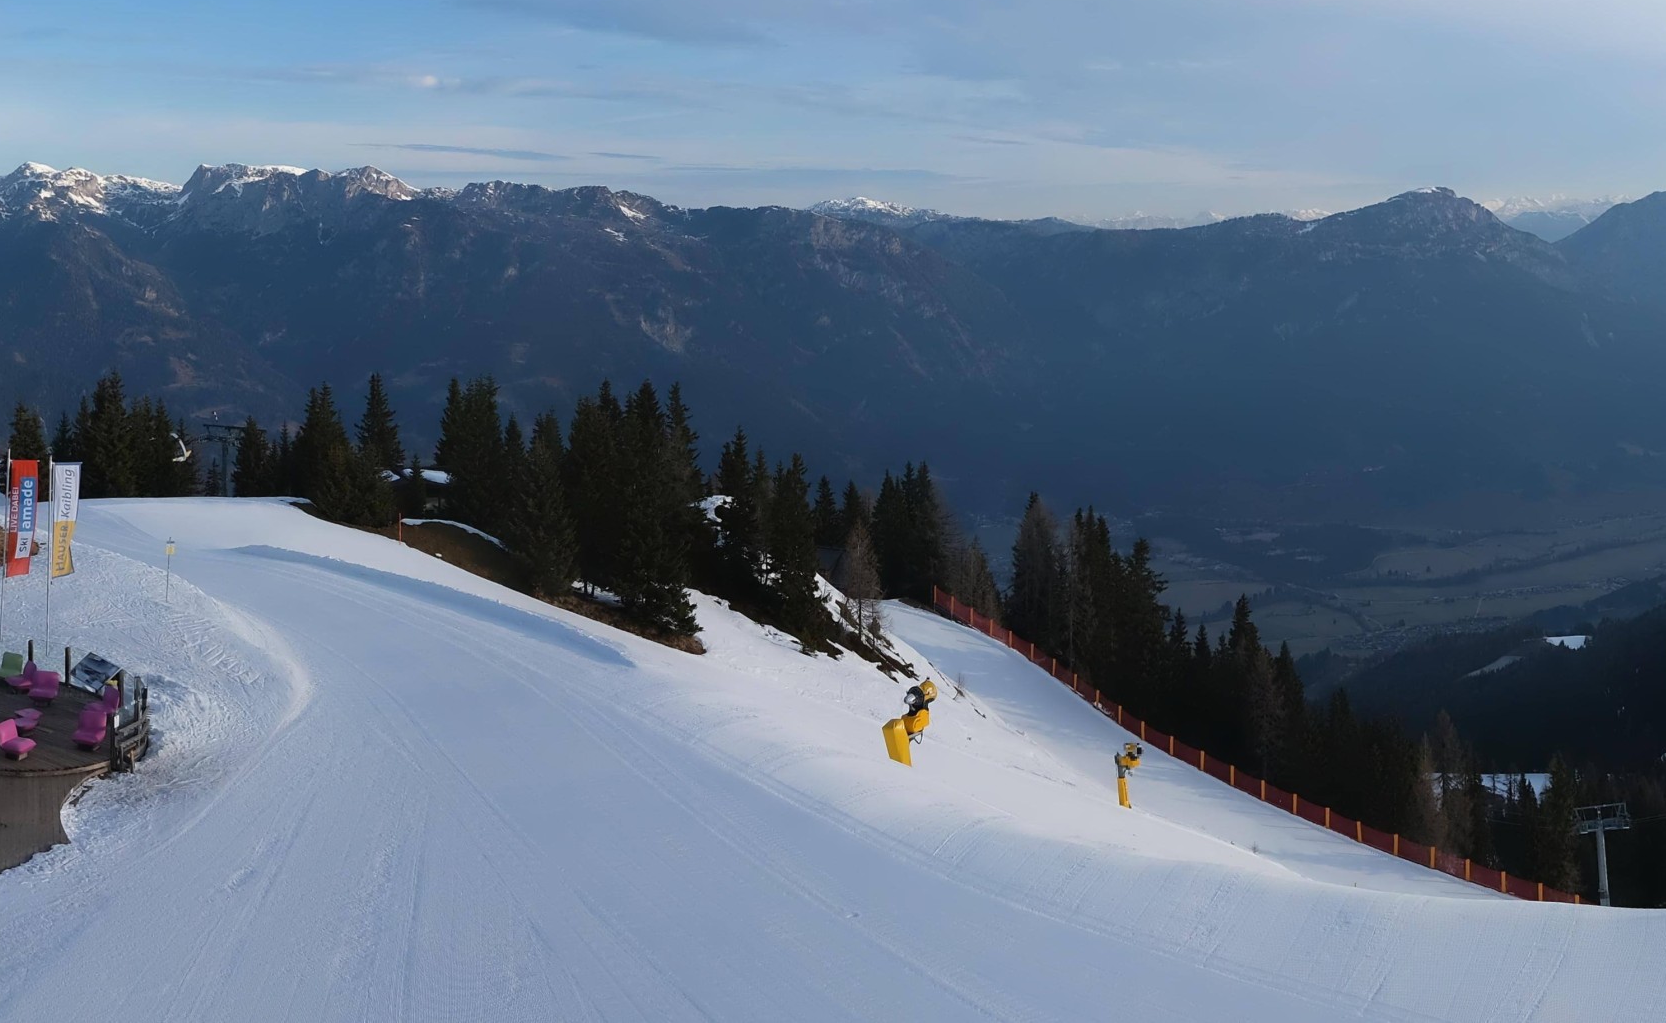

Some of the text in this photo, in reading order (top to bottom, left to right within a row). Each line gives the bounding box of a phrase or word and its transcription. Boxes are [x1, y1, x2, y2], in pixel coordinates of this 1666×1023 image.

[10, 487, 19, 532] LIVE DABEI
[56, 469, 75, 571] HAUSER Kaibling
[19, 538, 29, 552] Ski
